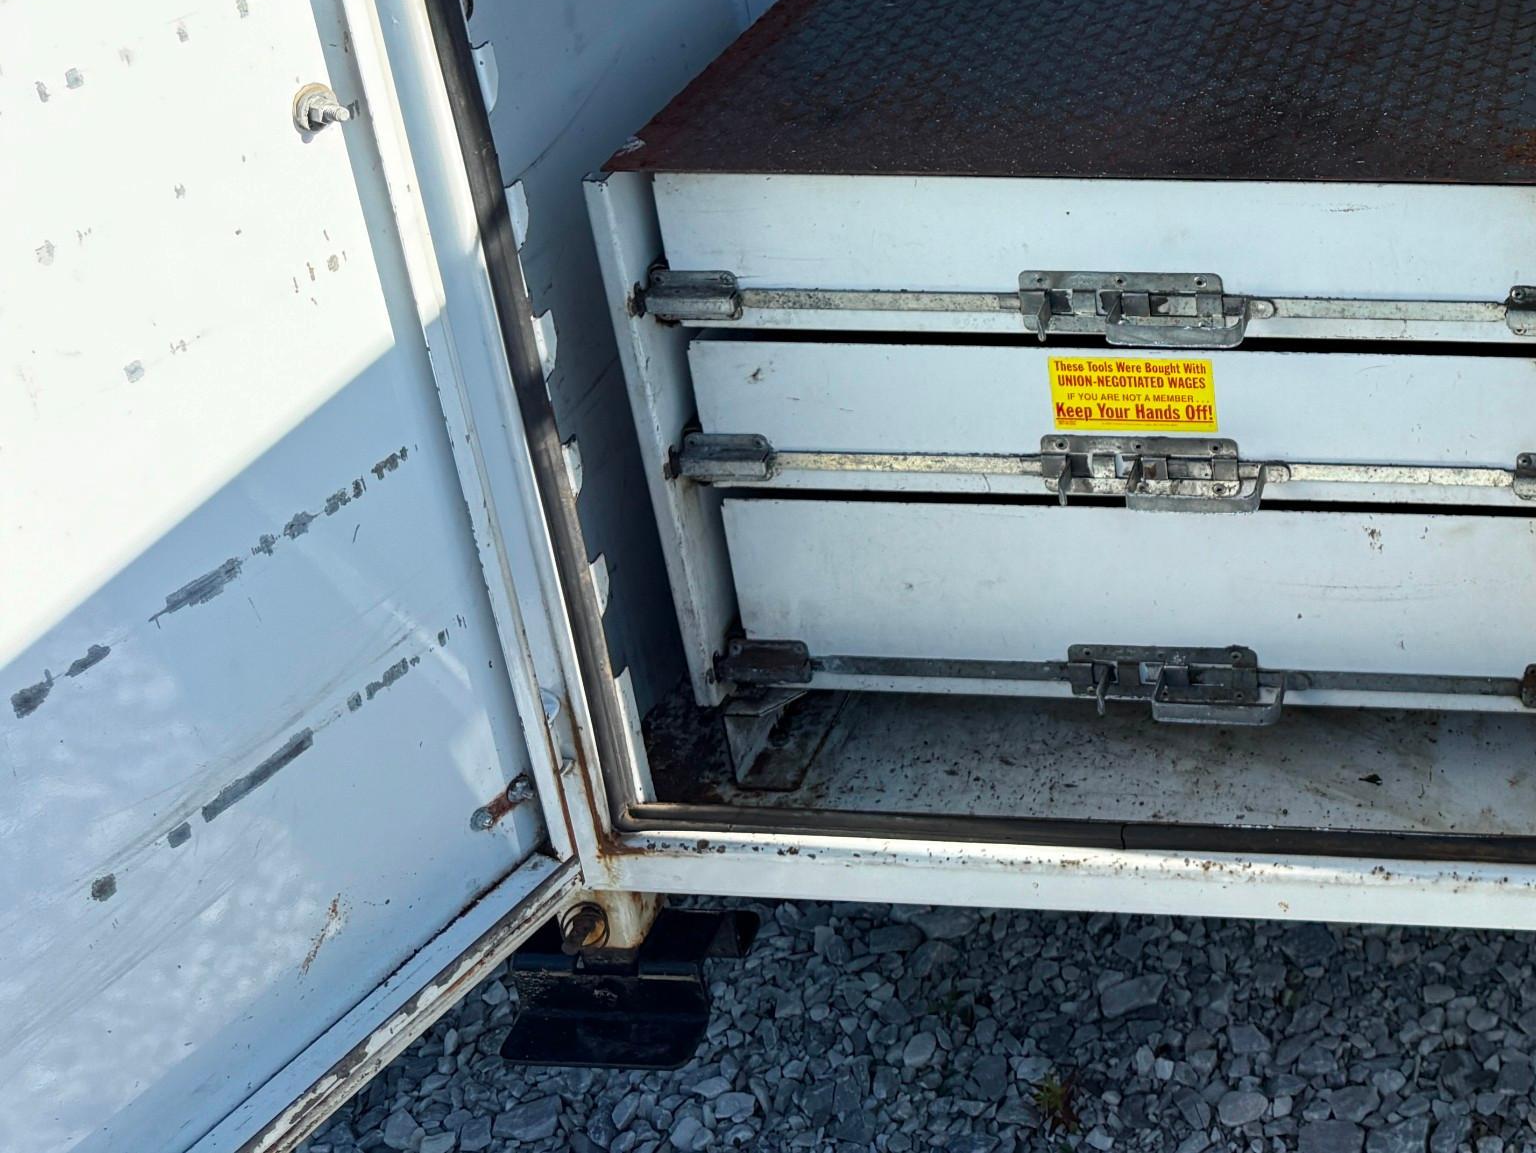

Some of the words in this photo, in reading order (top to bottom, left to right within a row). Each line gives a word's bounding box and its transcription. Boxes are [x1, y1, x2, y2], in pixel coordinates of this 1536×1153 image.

[1053, 360, 1084, 373] These
[1087, 360, 1114, 373] Tools
[1115, 361, 1142, 374] Were
[1145, 362, 1181, 376] Bought
[1183, 362, 1207, 375] With
[1057, 374, 1165, 389] UNION-NEGOTIATED
[1168, 376, 1207, 390] WAGES
[1067, 392, 1076, 400] IF
[1078, 392, 1098, 401] YOU
[1100, 393, 1120, 402] ARE
[1122, 393, 1142, 402] NOT
[1144, 394, 1151, 402] A
[1055, 402, 1093, 422] Keep
[1096, 402, 1131, 420] Your
[1135, 403, 1181, 421] Hands
[1185, 404, 1214, 422] Off!
